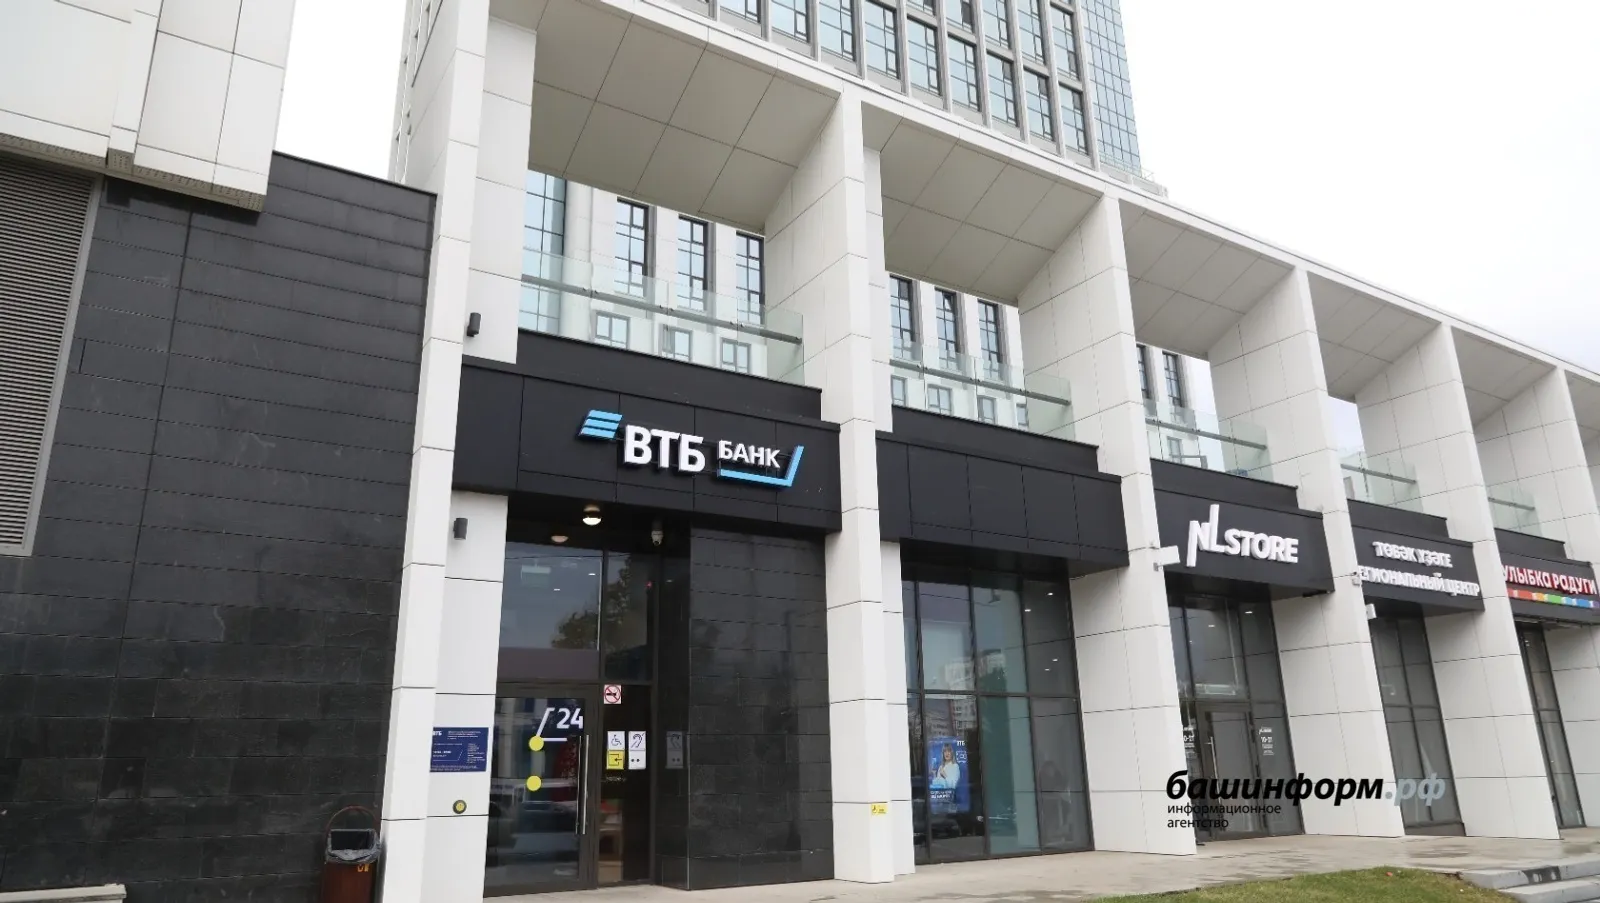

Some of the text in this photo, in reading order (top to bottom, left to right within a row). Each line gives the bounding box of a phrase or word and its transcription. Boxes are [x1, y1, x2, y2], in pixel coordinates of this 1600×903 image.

[624, 424, 780, 472] ВТБ БАНК
[1358, 565, 1480, 597] ЕГИОНАЛЬНЫЙ ЦЕНТР
[556, 706, 584, 730] 24
